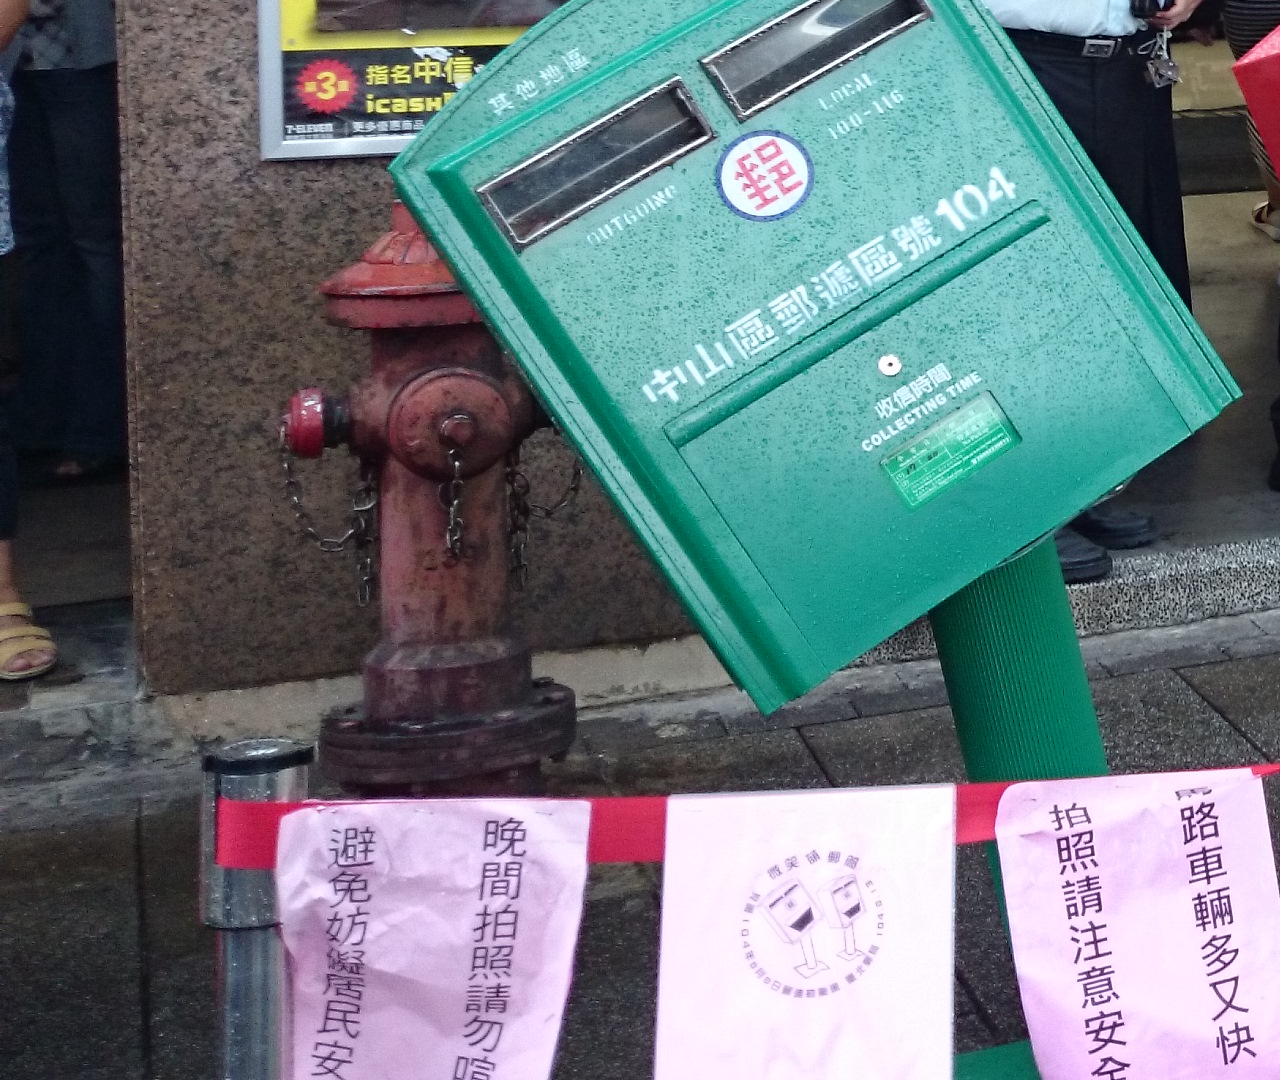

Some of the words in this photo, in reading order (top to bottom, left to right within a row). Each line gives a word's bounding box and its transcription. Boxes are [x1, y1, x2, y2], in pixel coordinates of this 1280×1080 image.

[366, 92, 456, 114] icash
[488, 47, 591, 115] 其他地區
[817, 72, 878, 110] LOCAL
[828, 90, 905, 140] 100-116
[586, 184, 678, 245] OUTGOING
[642, 215, 942, 404] 中山區郵遞區號
[935, 166, 1017, 232] 104
[861, 394, 948, 453] COLLECTING
[945, 371, 983, 400] TIME
[874, 362, 953, 420] 收信時間
